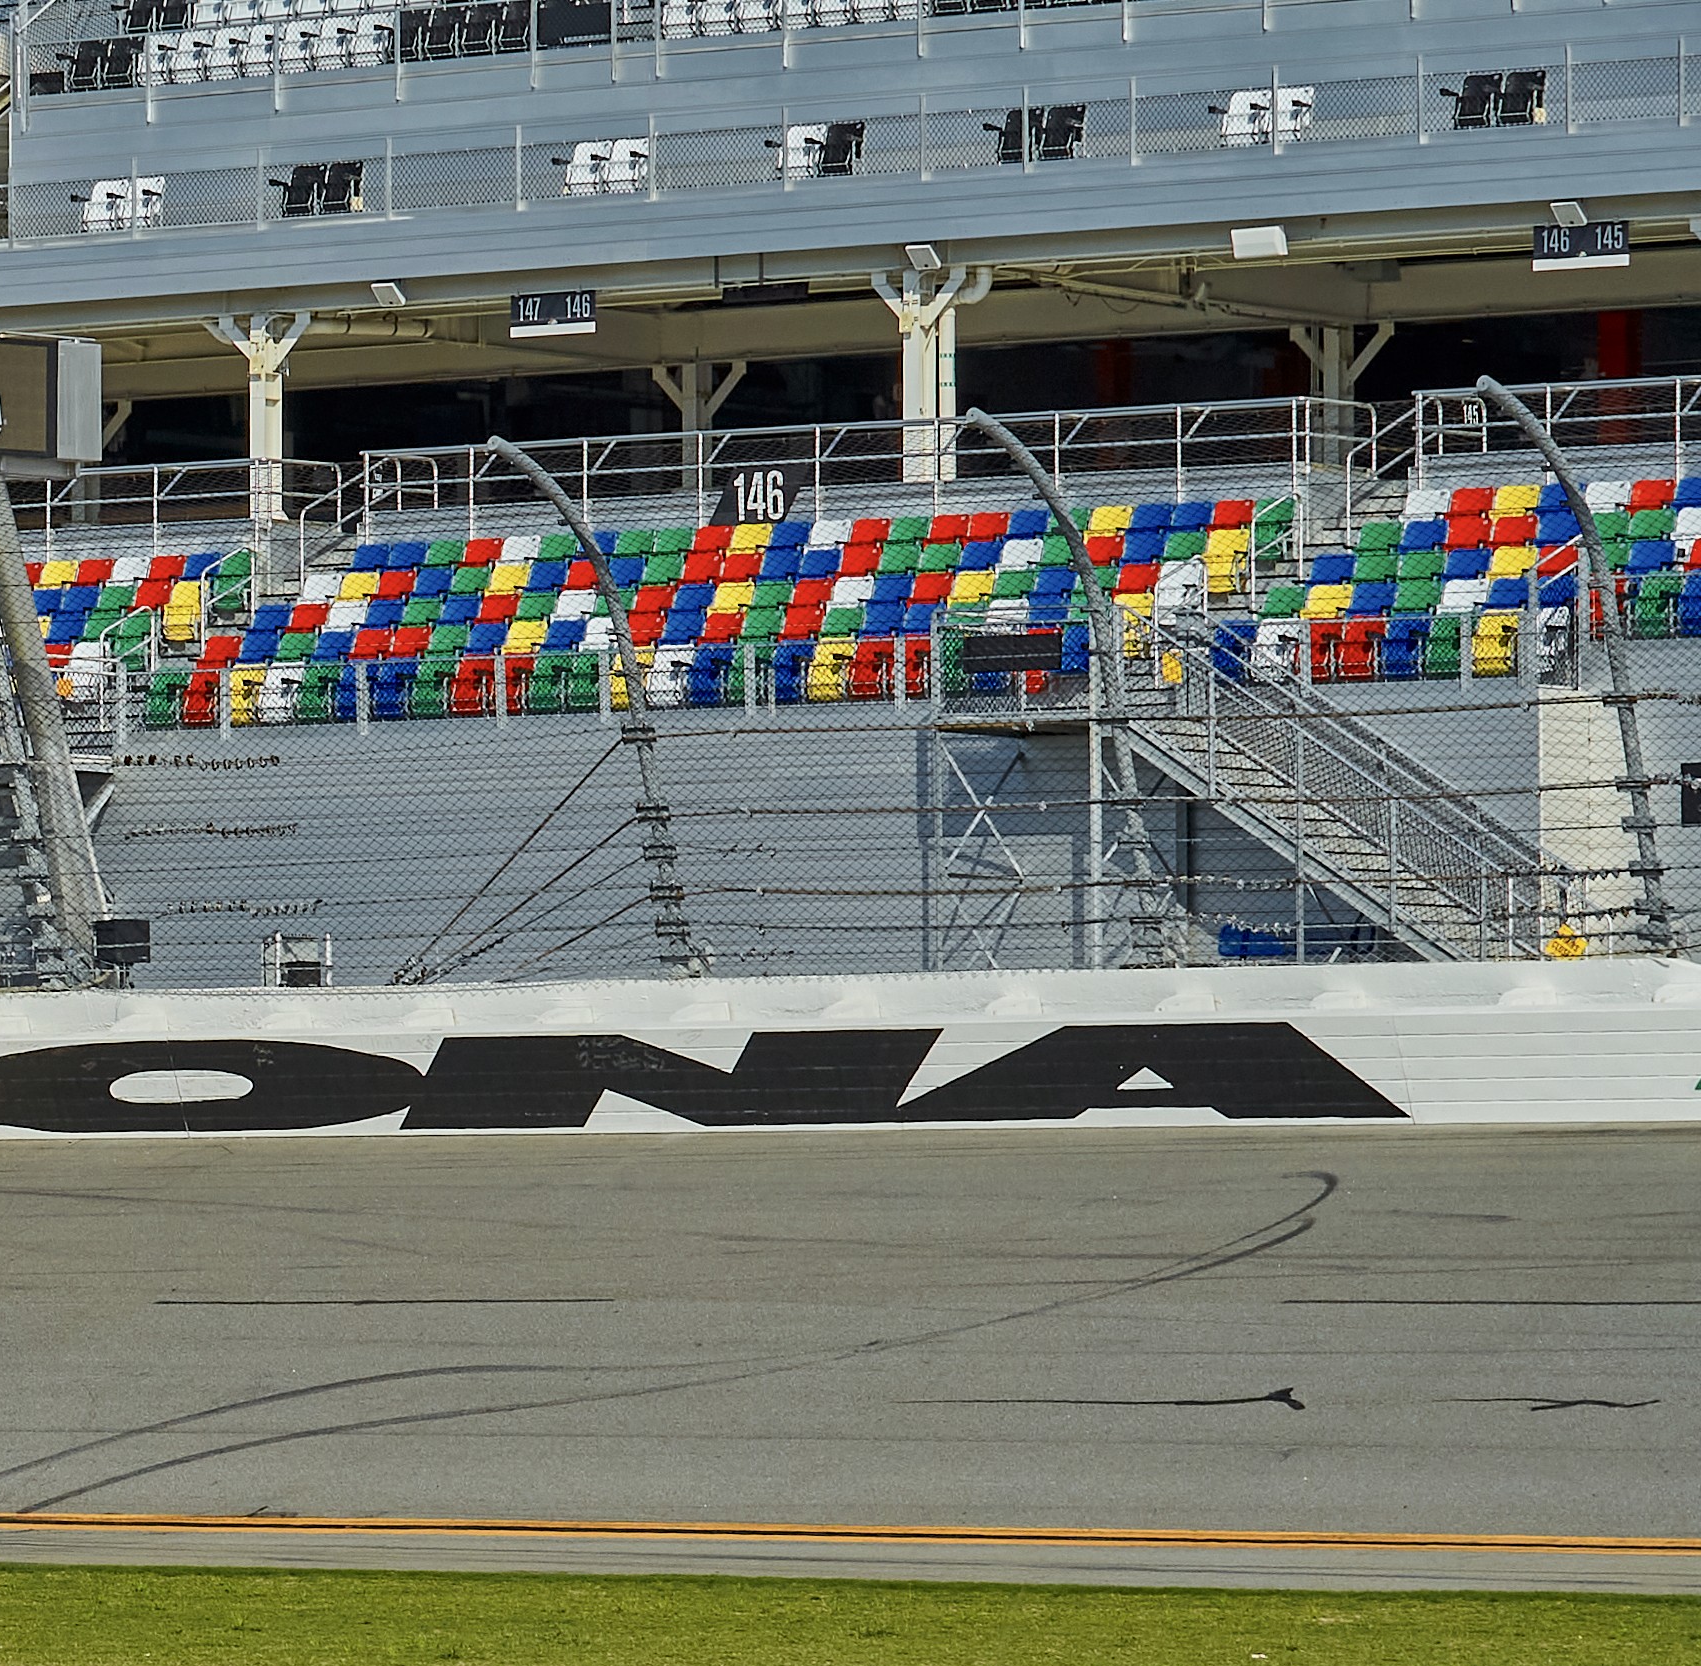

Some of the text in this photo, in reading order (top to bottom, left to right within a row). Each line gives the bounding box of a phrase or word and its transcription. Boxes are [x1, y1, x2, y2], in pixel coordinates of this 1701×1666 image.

[1542, 225, 1623, 253] 146 145
[518, 294, 591, 321] 147 146
[733, 470, 784, 521] 146
